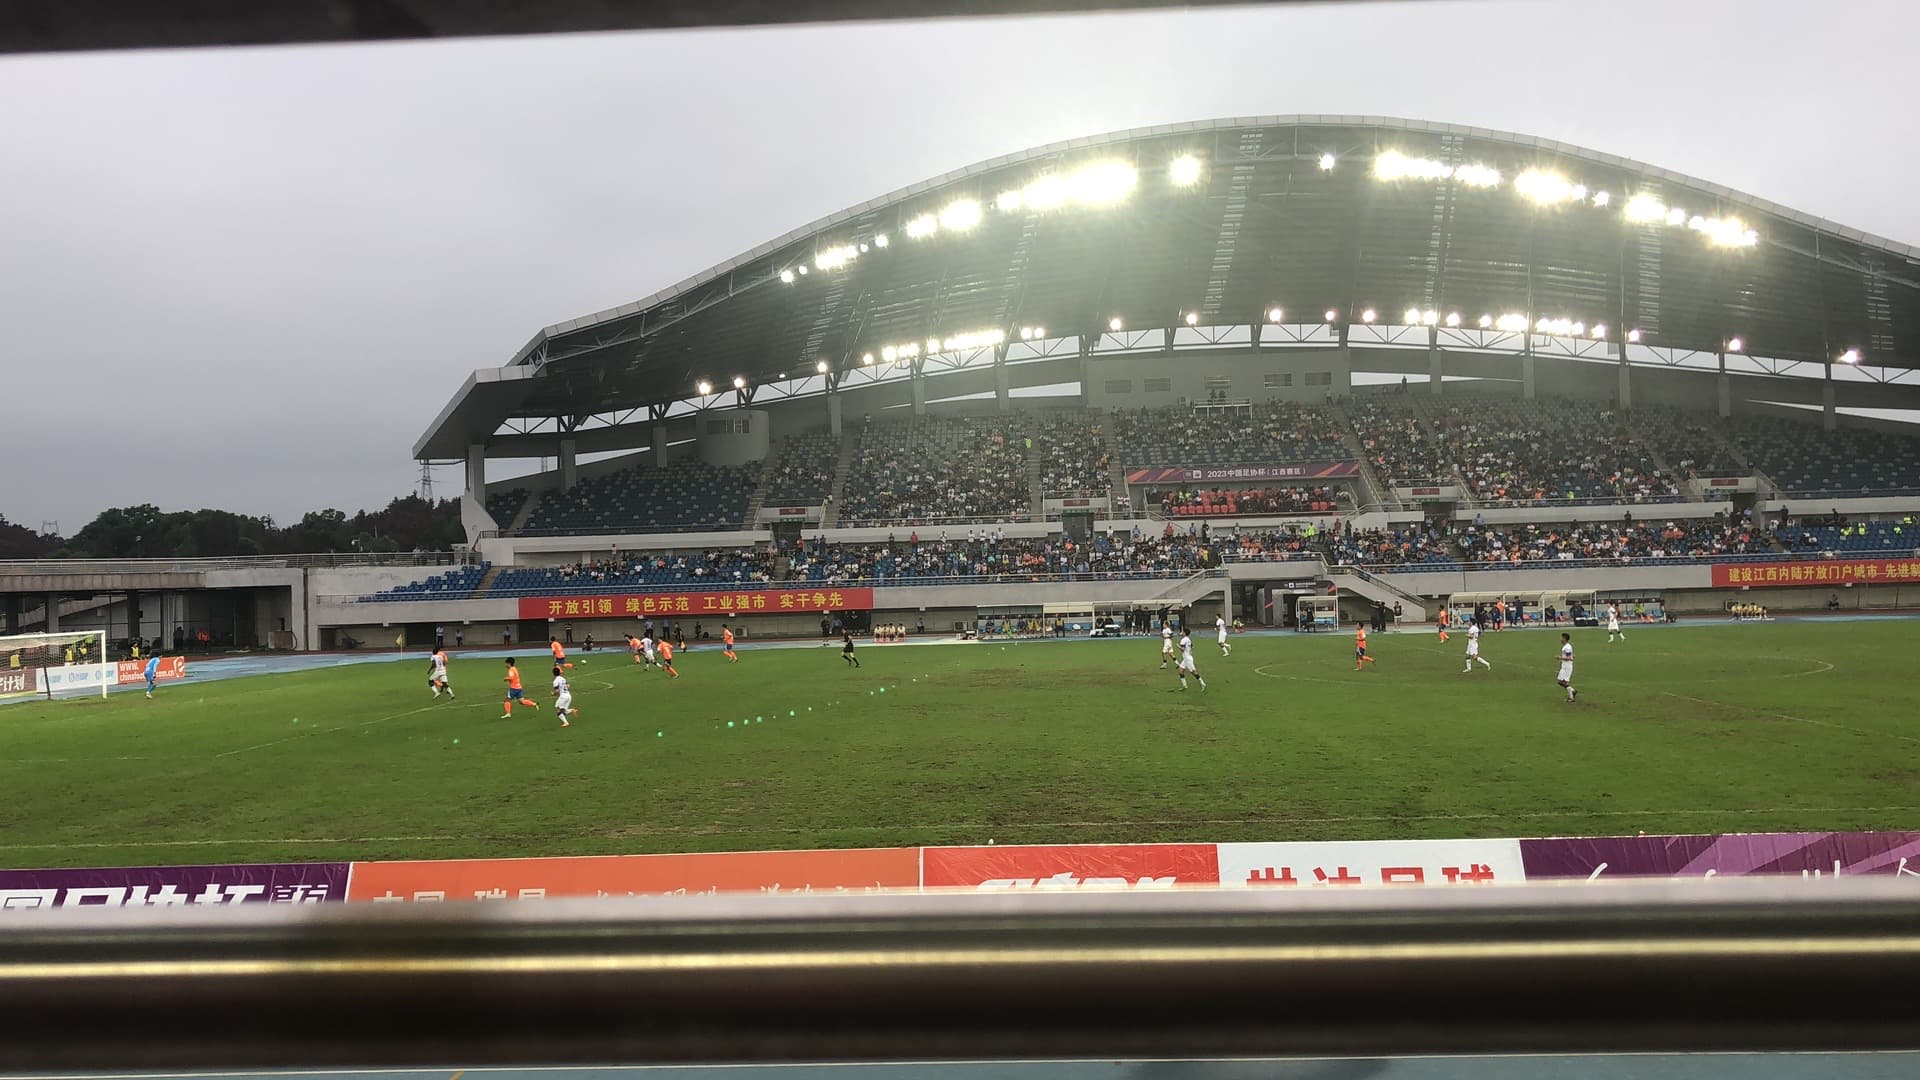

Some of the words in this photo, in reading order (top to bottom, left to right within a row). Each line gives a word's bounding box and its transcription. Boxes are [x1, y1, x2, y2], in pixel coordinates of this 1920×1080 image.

[1728, 564, 1878, 582] 建设江西内陆开放门户城市
[549, 599, 612, 615] 开放引领
[626, 597, 689, 613] 绿色示范
[703, 595, 766, 610] 工业强市
[780, 592, 844, 608] 实干争先
